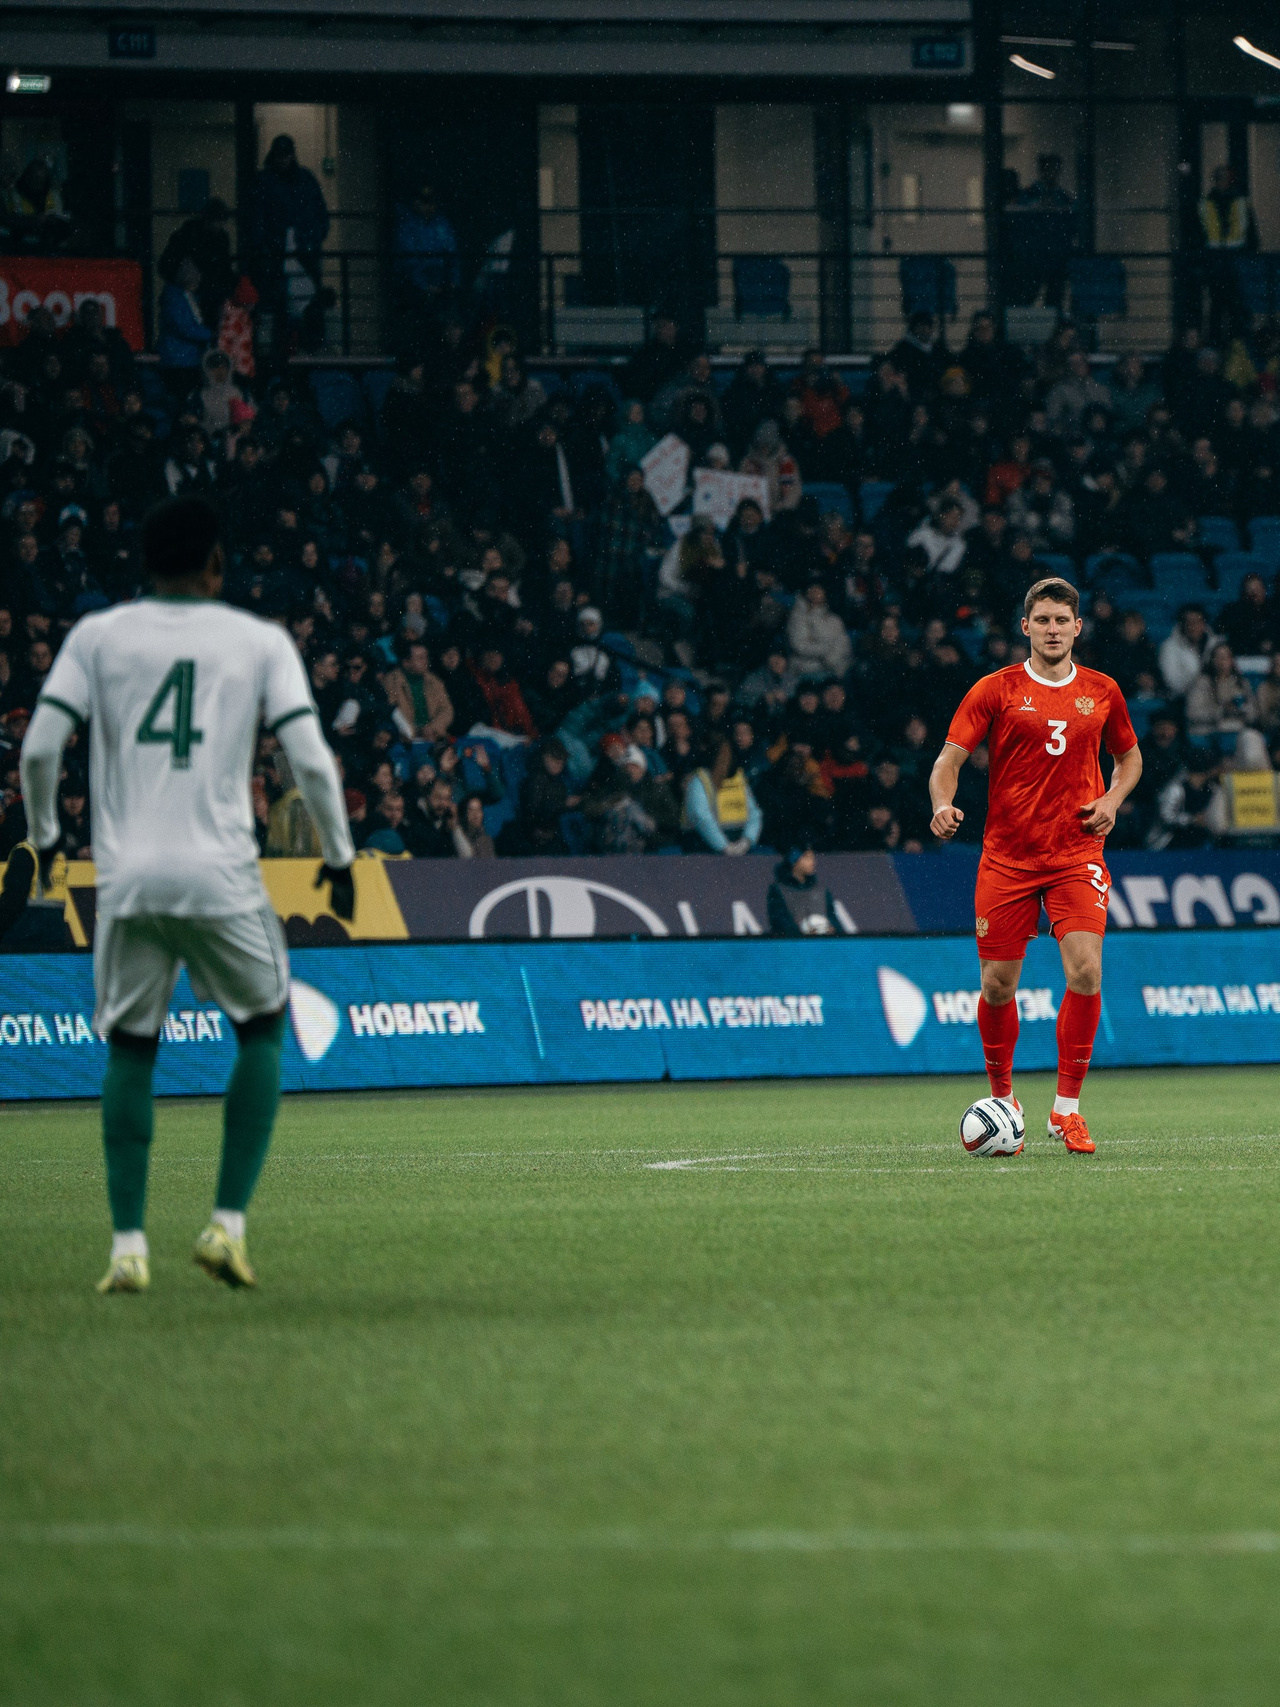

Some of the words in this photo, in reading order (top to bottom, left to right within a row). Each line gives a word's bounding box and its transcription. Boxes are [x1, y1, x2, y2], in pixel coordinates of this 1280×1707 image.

[136, 659, 204, 770] 4
[1045, 719, 1068, 756] 3
[1087, 863, 1108, 893] 3
[0, 1013, 52, 1045] ОТА
[53, 1012, 94, 1045] НА
[348, 1000, 486, 1037] НОВАТЭК
[580, 998, 672, 1031] РАБОТА
[670, 998, 709, 1029] НА
[707, 995, 824, 1028] РЕЗУЛЬТАТ
